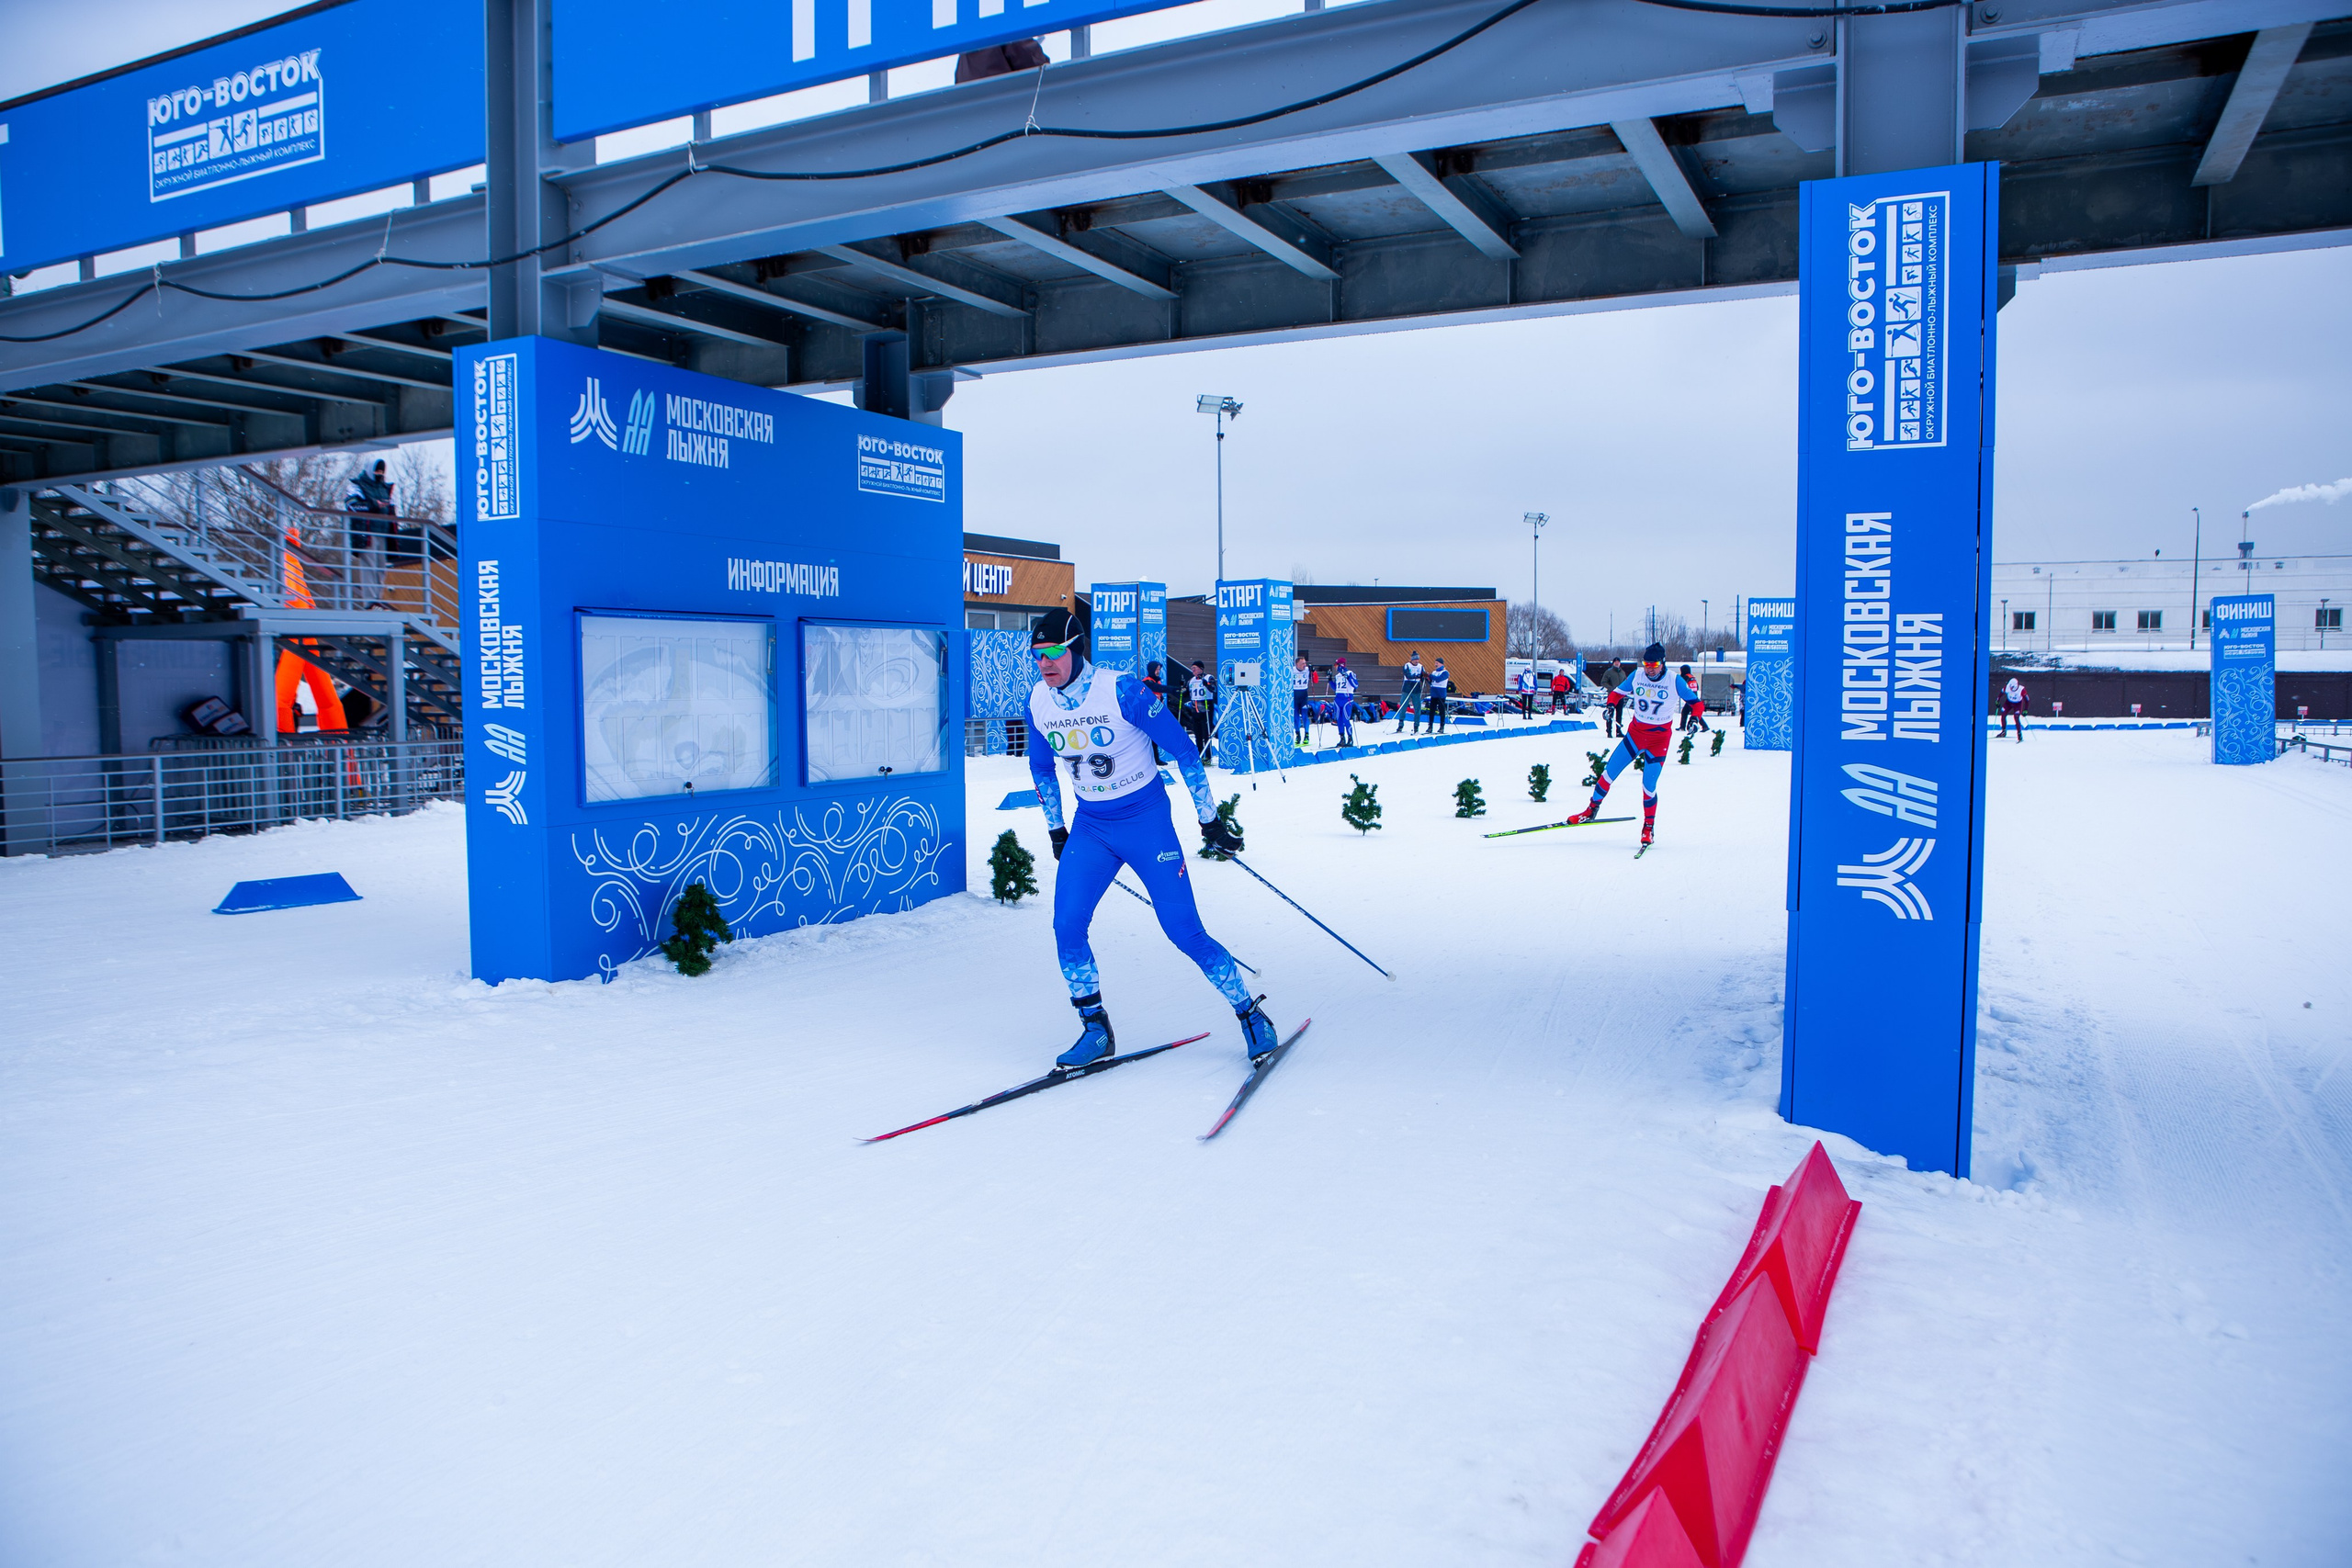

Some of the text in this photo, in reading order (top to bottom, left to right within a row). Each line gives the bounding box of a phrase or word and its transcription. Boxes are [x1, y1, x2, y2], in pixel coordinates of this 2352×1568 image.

[148, 48, 322, 127] ЮГО-ВОСТОК
[154, 169, 194, 189] ОКРУЖНОЙ
[1847, 202, 1877, 451] ЮГО-ВОСТОК
[1924, 204, 1938, 441] ОКРУЖНОЙ БИАТЛОННО-ЛЫЖНЫЙ КОМПЛЕКС
[666, 393, 774, 444] МОСКОВСКАЯ
[474, 360, 490, 521] ЮГО-ВОСТОК
[666, 428, 729, 469] ЛЫЖНЯ
[857, 434, 944, 465] ЮГО-ВОСТОК
[728, 557, 839, 600] ИНФОРМАЦИЯ
[974, 562, 1012, 596] ЦЕНТР
[1218, 584, 1263, 608] СТАРТ
[1093, 591, 1137, 613] СТАРТ
[1749, 602, 1795, 618] ФИНИШ
[2216, 601, 2272, 621] ФИНИШ
[478, 559, 503, 709] МОСКОВСКАЯ
[1841, 512, 1893, 740] МОСКОВСКАЯ
[502, 625, 525, 709] ЛЫЖНЯ
[1893, 613, 1943, 743] ЛЫЖНЯ
[1044, 715, 1110, 730] VMARAFONE
[1638, 698, 1665, 716] 97
[1062, 752, 1115, 781] 79
[1066, 1069, 1086, 1079] ATOMIC
